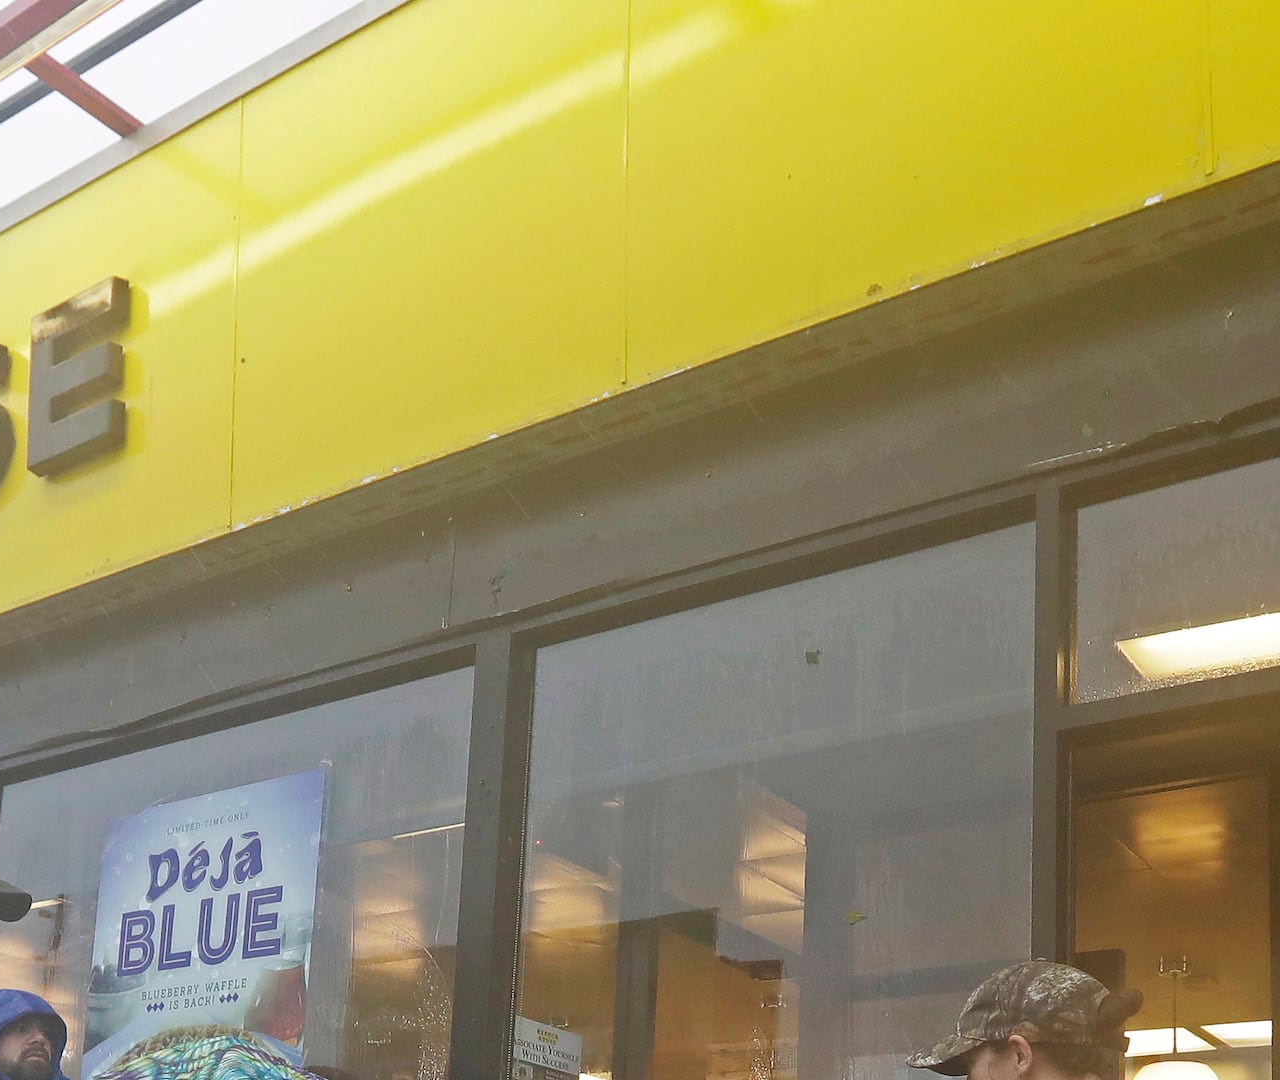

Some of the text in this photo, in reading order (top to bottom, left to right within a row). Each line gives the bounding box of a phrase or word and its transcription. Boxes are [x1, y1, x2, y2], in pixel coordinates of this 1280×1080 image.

[167, 811, 250, 836] LIMITED TIME ONLY
[117, 886, 283, 977] BLUE
[141, 978, 248, 1001] BLUEBERRY WAFFLE
[169, 995, 215, 1010] IS BACK!
